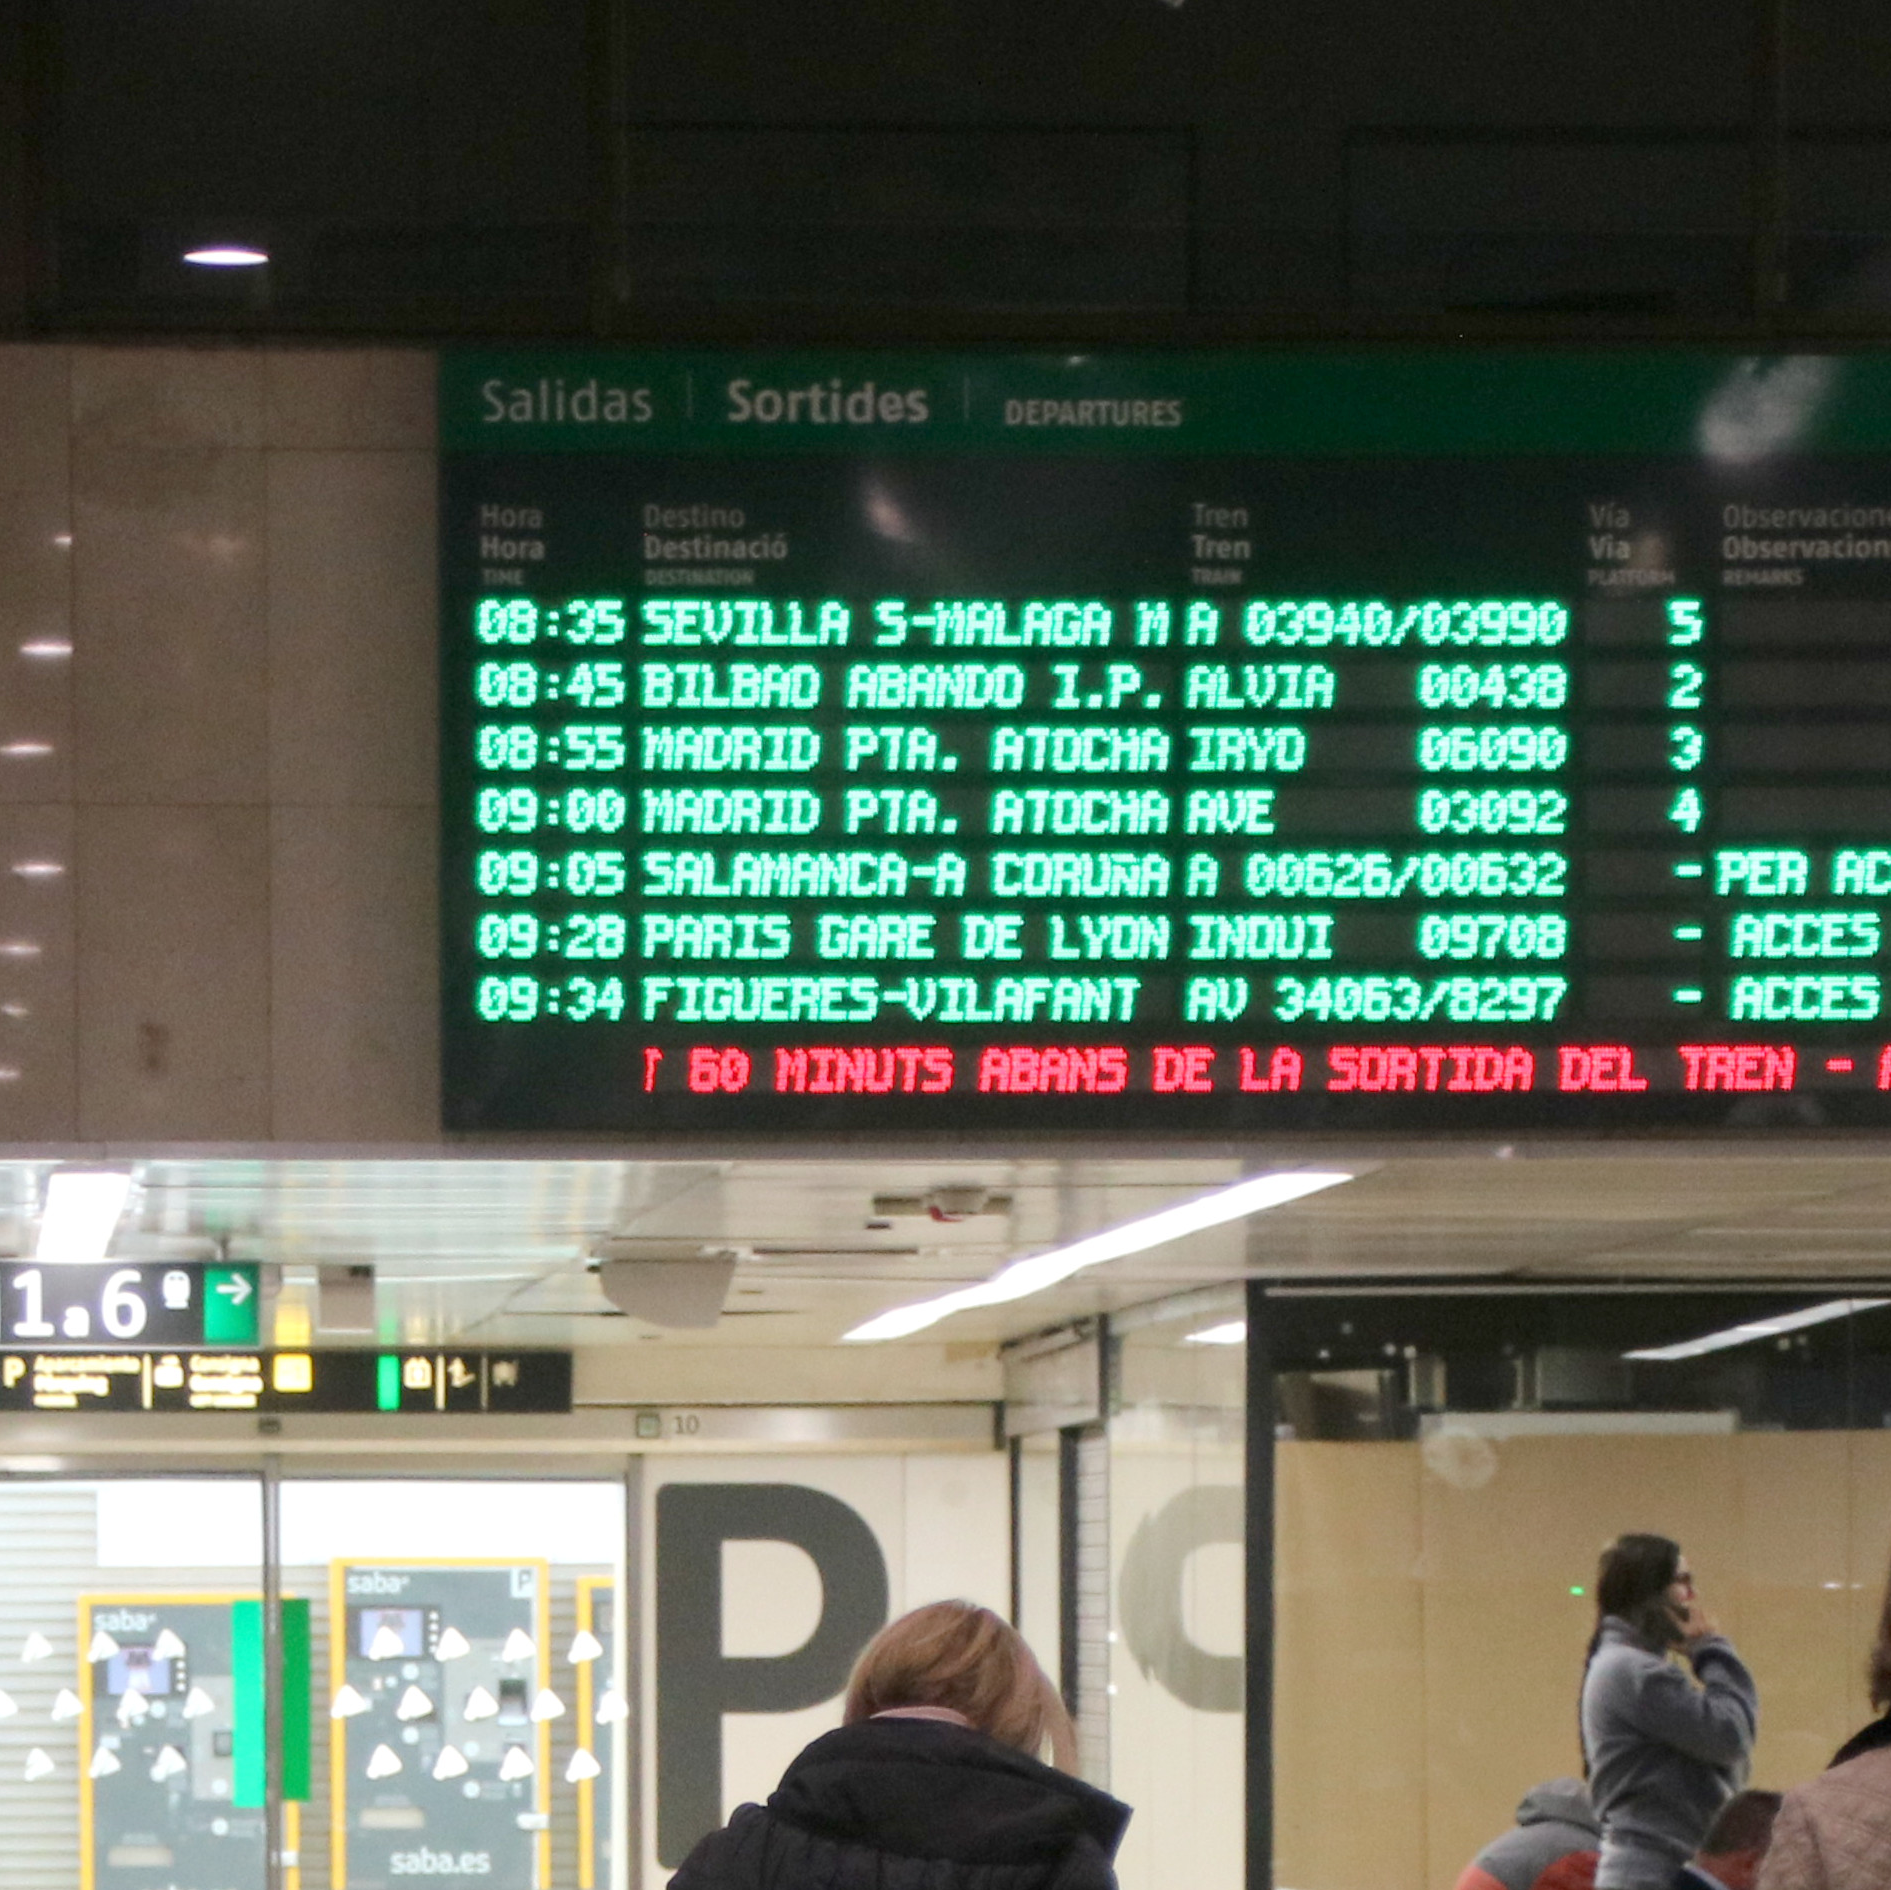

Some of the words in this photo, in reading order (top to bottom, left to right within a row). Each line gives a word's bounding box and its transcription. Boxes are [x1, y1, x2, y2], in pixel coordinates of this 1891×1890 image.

[482, 379, 654, 422] Salidas
[728, 378, 930, 425] Sortides
[1004, 398, 1183, 428] DEPARTURES
[480, 503, 543, 529] Hora
[643, 503, 745, 529] Destino
[1193, 504, 1248, 529] Tren
[1590, 502, 1631, 529] Vía
[480, 535, 545, 561] Hora
[643, 532, 788, 561] Destinació
[1192, 535, 1251, 561] Tren
[1590, 534, 1631, 561] Via
[481, 567, 524, 586] TIME
[644, 567, 755, 586] DESTINATION
[1192, 567, 1243, 586] TRAIN
[1588, 568, 1676, 587] PLATFORM
[1722, 569, 1805, 587] REMARKS
[475, 598, 627, 648] 08:35
[639, 598, 853, 648] SEVILLA
[872, 598, 1114, 648] S-MALAGA
[1133, 598, 1172, 648] M
[1184, 598, 1221, 648] A
[1241, 598, 1570, 648] 03940/03990
[1665, 598, 1704, 648] 5
[474, 660, 627, 711] 08:45
[638, 660, 823, 711] BILBAO
[843, 660, 1027, 711] ABANDO
[1049, 660, 1162, 711] I.P.
[1184, 660, 1337, 711] ALVIA
[1415, 660, 1569, 711] 00438
[1667, 660, 1705, 711] 2
[475, 723, 627, 774] 08:55
[639, 723, 822, 774] MADRID
[842, 723, 959, 774] PTA.
[989, 723, 1172, 774] ATOCHA
[1187, 723, 1308, 774] IRYO
[1415, 723, 1569, 774] 06090
[1669, 723, 1704, 774] 3
[475, 786, 628, 836] 09:00
[639, 786, 823, 836] MADRID
[842, 786, 959, 836] PTA.
[989, 786, 1171, 836] ATOCHA
[1183, 786, 1276, 836] AVE
[1416, 786, 1569, 836] 03092
[1667, 786, 1703, 836] 4
[475, 847, 627, 899] 09:05
[640, 847, 969, 899] SALAMANCA-A
[989, 847, 1172, 899] CORUÑA
[1184, 847, 1221, 899] A
[1242, 847, 1568, 899] 00626/00632
[1716, 847, 1811, 899] PER
[475, 910, 628, 961] 09:28
[639, 910, 793, 961] PARIS
[814, 910, 937, 961] GARE
[959, 910, 1025, 961] DE
[1047, 910, 1173, 961] LYON
[1187, 910, 1335, 961] INOUI
[1416, 910, 1569, 961] 09708
[1729, 910, 1882, 961] ACCES
[475, 972, 626, 1023] 09:34
[640, 972, 1142, 1023] FIGUERES-VILAFANT
[1184, 972, 1250, 1023] AV
[1273, 972, 1568, 1023] 34063/8297
[1729, 972, 1882, 1023] ACCES
[687, 1044, 753, 1094] 60
[773, 1044, 956, 1094] MINUTS
[976, 1044, 1130, 1094] ABANS
[1150, 1044, 1217, 1094] DE
[1238, 1044, 1305, 1094] LA
[1325, 1044, 1537, 1094] SORTIDA
[1557, 1044, 1650, 1094] DEL
[1677, 1044, 1799, 1094] TREN
[12, 1269, 55, 1338] 1
[63, 1304, 92, 1338] a
[100, 1269, 149, 1338] 6
[3, 1357, 26, 1388] P
[673, 1414, 700, 1435] 10
[347, 1572, 402, 1594] saba
[656, 1483, 890, 1869] P
[389, 1846, 491, 1875] saba.es
